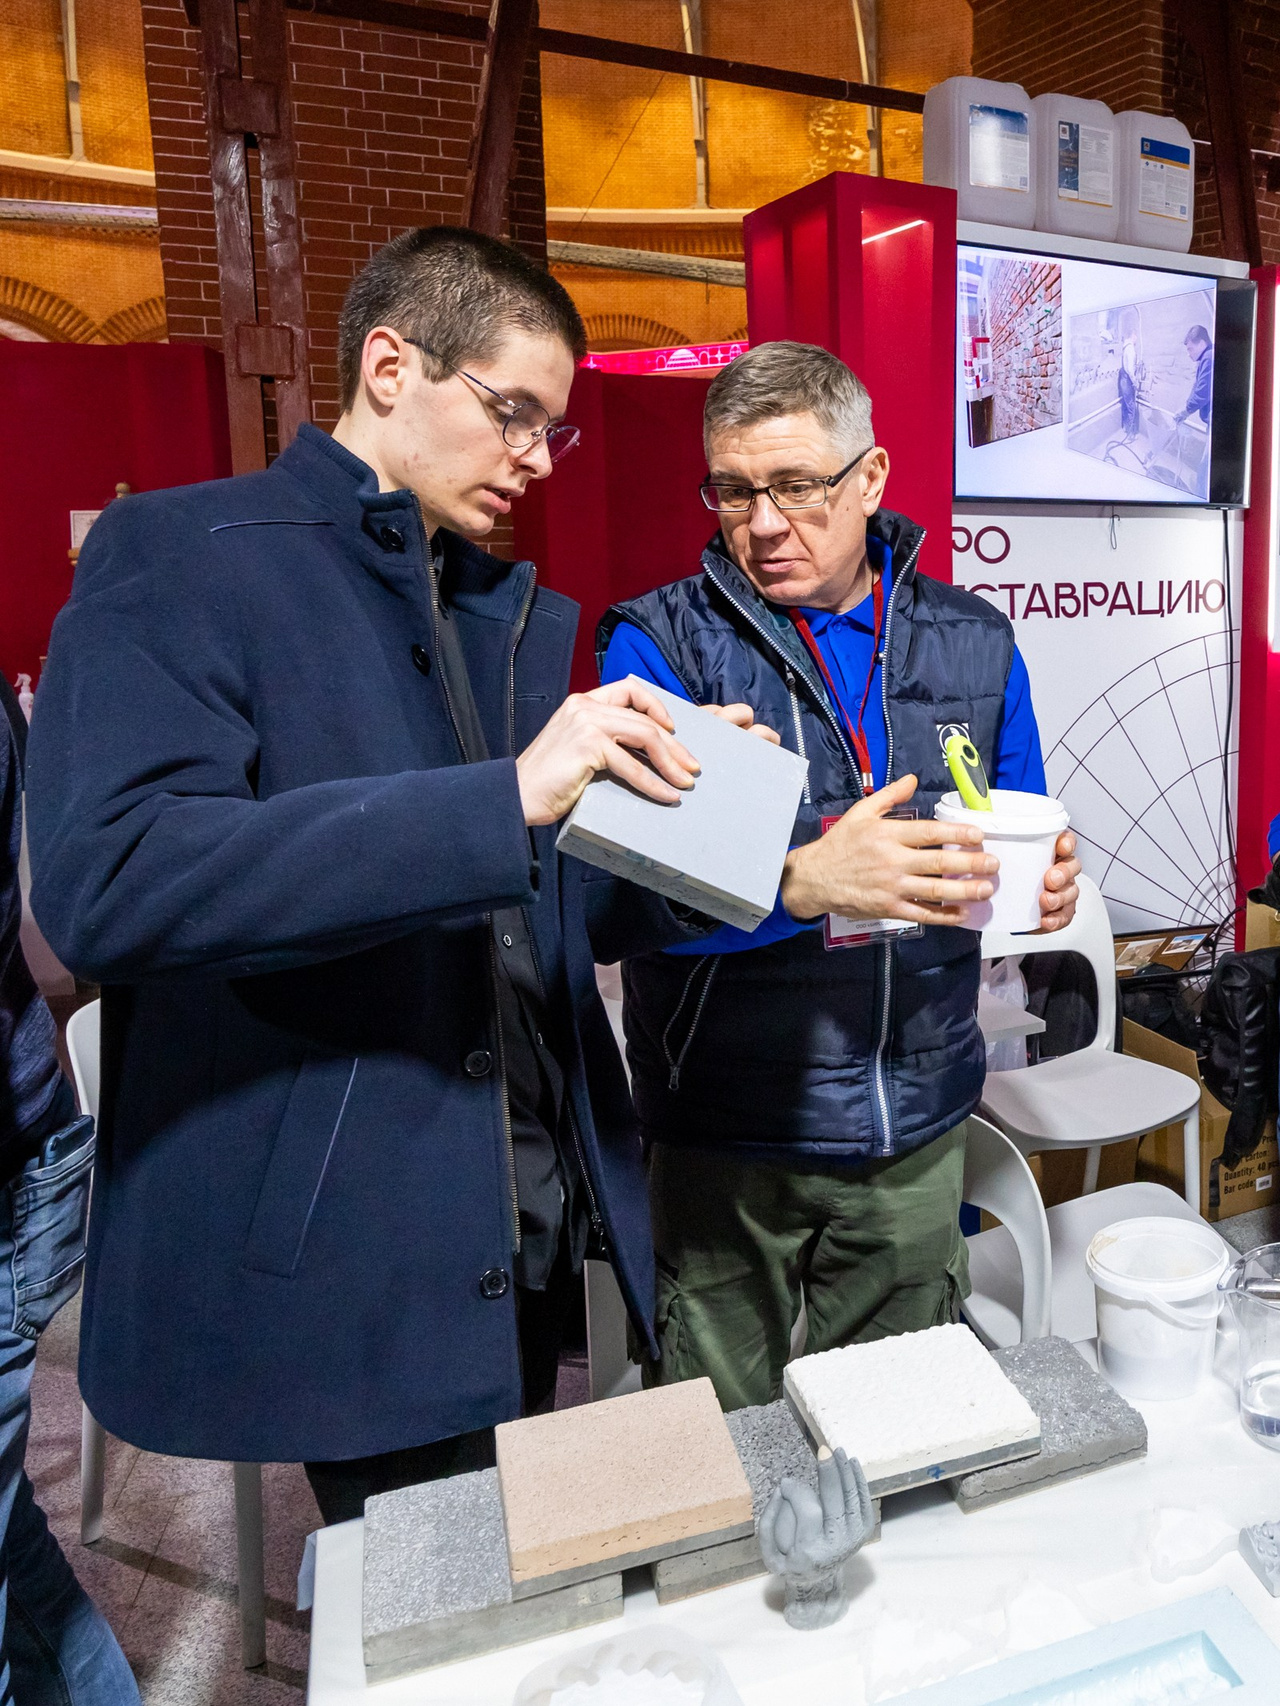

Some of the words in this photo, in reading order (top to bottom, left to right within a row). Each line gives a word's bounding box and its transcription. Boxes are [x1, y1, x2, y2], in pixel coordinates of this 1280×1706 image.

[952, 577, 1226, 620] ТАВРАЦИЮ
[1224, 1166, 1255, 1181] Quantity:
[1257, 1161, 1266, 1172] 40
[1224, 1185, 1236, 1195] Bar
